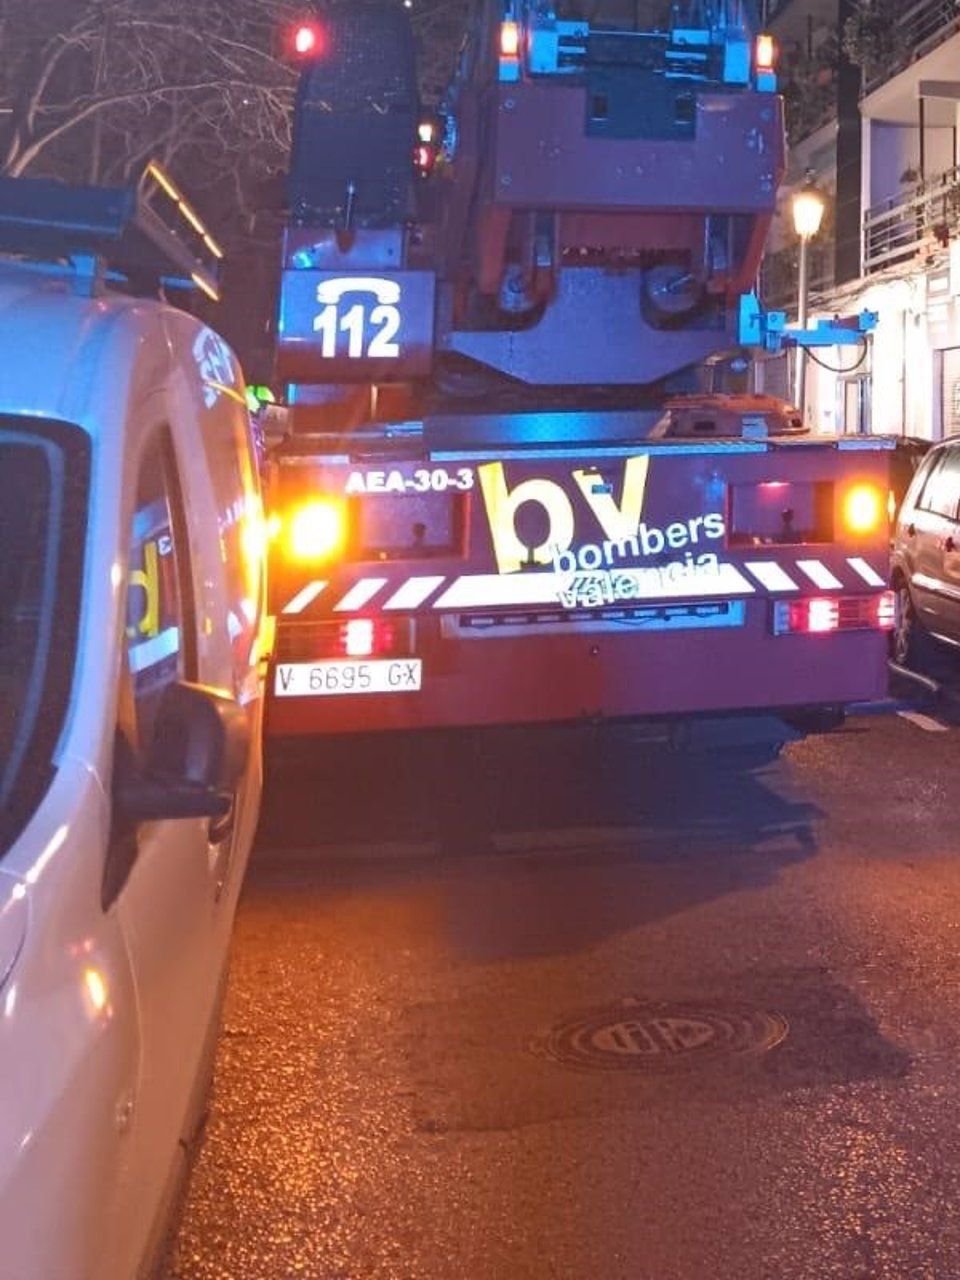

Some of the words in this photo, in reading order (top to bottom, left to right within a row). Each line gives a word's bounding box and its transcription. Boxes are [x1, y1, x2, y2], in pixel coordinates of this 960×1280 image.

[313, 303, 401, 358] 112
[344, 468, 474, 493] AEA-30-3
[551, 512, 726, 576] bombers
[279, 667, 293, 691] V
[309, 665, 372, 690] 6695
